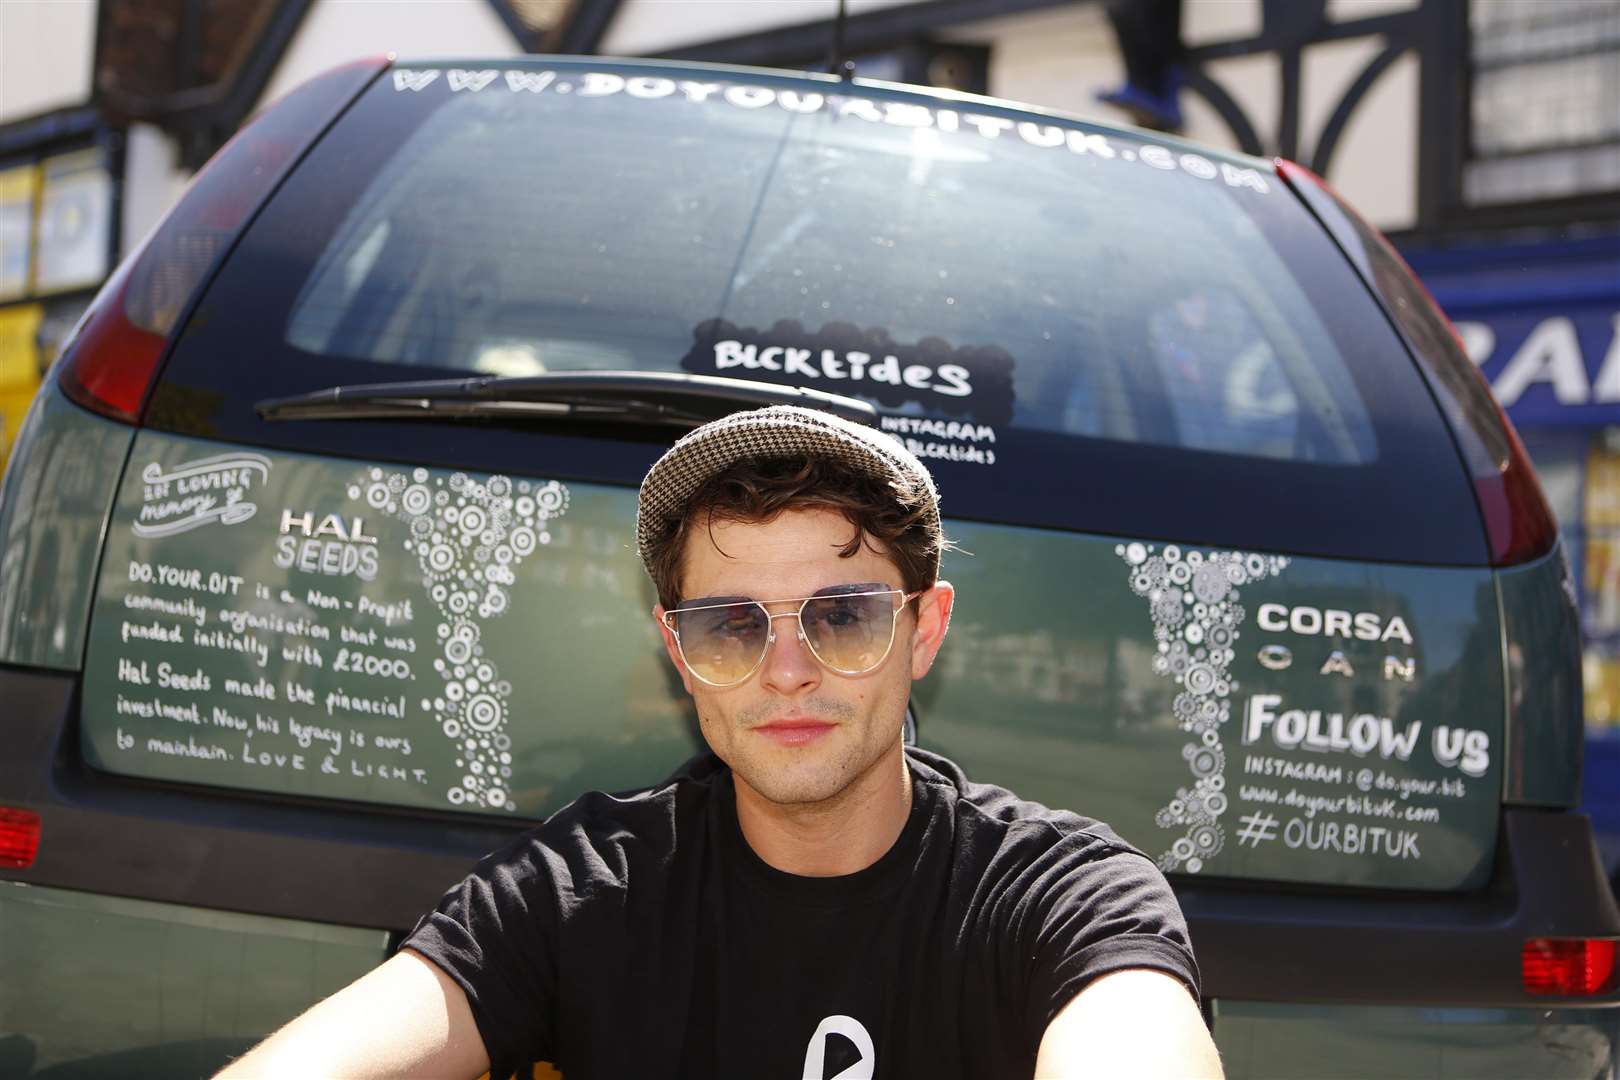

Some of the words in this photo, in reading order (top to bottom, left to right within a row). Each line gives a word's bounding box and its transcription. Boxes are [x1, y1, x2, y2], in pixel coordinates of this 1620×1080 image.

[881, 416, 996, 443] INSTAGRAM
[177, 468, 251, 496] LOVING
[280, 509, 378, 544] HAL
[274, 535, 379, 581] SEEDS
[256, 583, 269, 600] is
[280, 590, 295, 603] a
[124, 594, 206, 626] community
[219, 609, 330, 640] organisation
[341, 625, 378, 646] that
[384, 636, 416, 652] was
[1257, 603, 1413, 644] CORSA
[194, 629, 269, 667] initially
[282, 645, 323, 668] with
[333, 648, 416, 680] £2000.
[118, 658, 150, 685] Hal
[158, 662, 211, 691] Seeds
[225, 678, 275, 700] made
[287, 681, 315, 705] the
[116, 727, 135, 750] to
[242, 743, 304, 771] LOVE
[321, 755, 340, 774] &
[256, 712, 280, 735] his
[289, 717, 342, 755] legacy
[349, 729, 365, 748] is
[375, 736, 411, 755] ours
